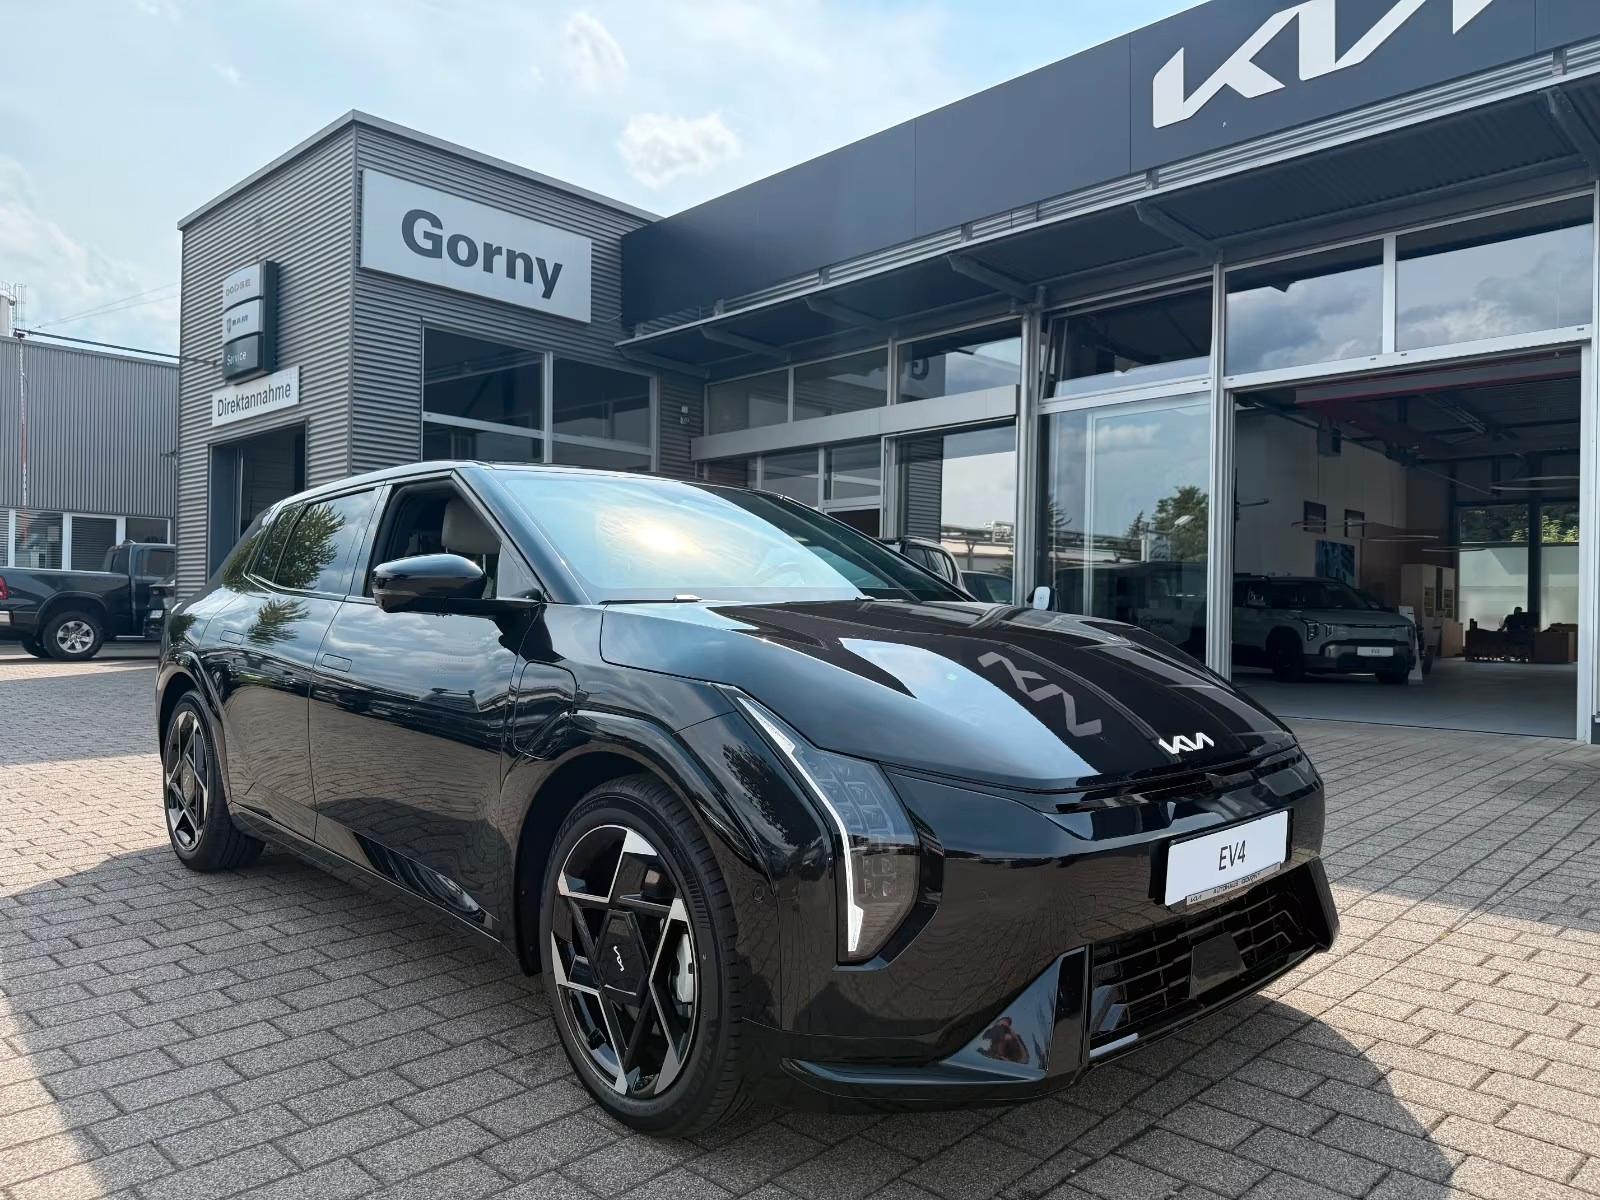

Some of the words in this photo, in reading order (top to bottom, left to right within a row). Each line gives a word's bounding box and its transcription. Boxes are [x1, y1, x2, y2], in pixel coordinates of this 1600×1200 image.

[401, 208, 563, 300] Gorny
[226, 350, 247, 367] Service
[217, 383, 291, 417] Direktannahme
[1158, 732, 1215, 755] KIA
[1218, 839, 1246, 871] EV4
